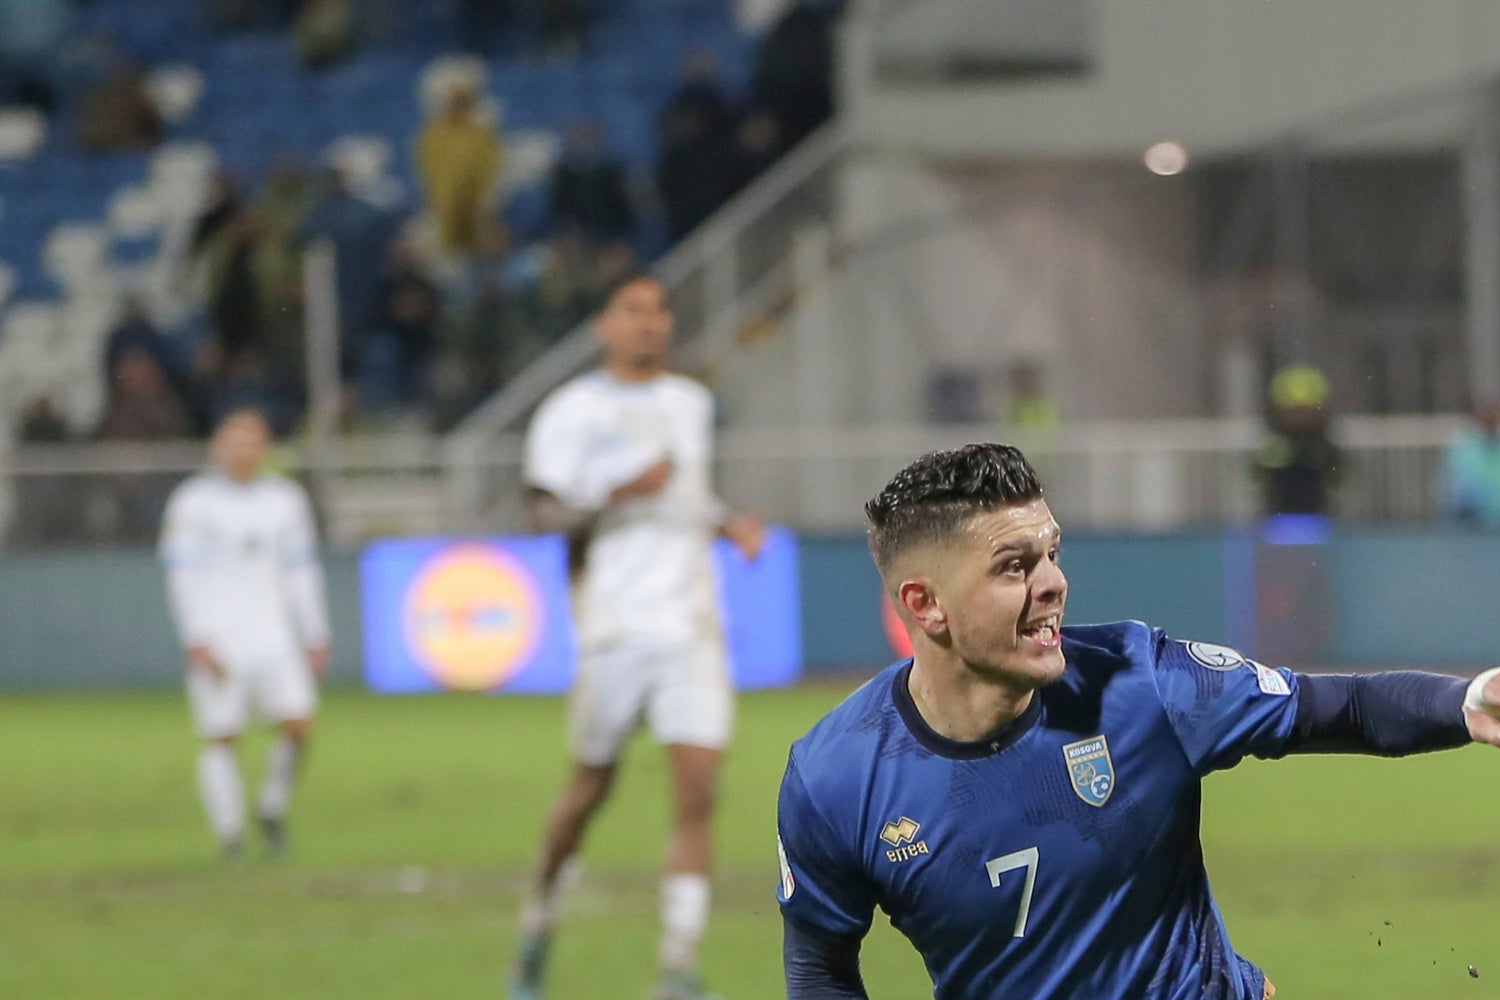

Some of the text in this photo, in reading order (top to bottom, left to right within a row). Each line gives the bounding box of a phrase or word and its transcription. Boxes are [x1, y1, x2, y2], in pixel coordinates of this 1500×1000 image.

[1068, 741, 1102, 759] KOSOVA
[886, 840, 929, 862] errea
[984, 846, 1040, 938] 7
